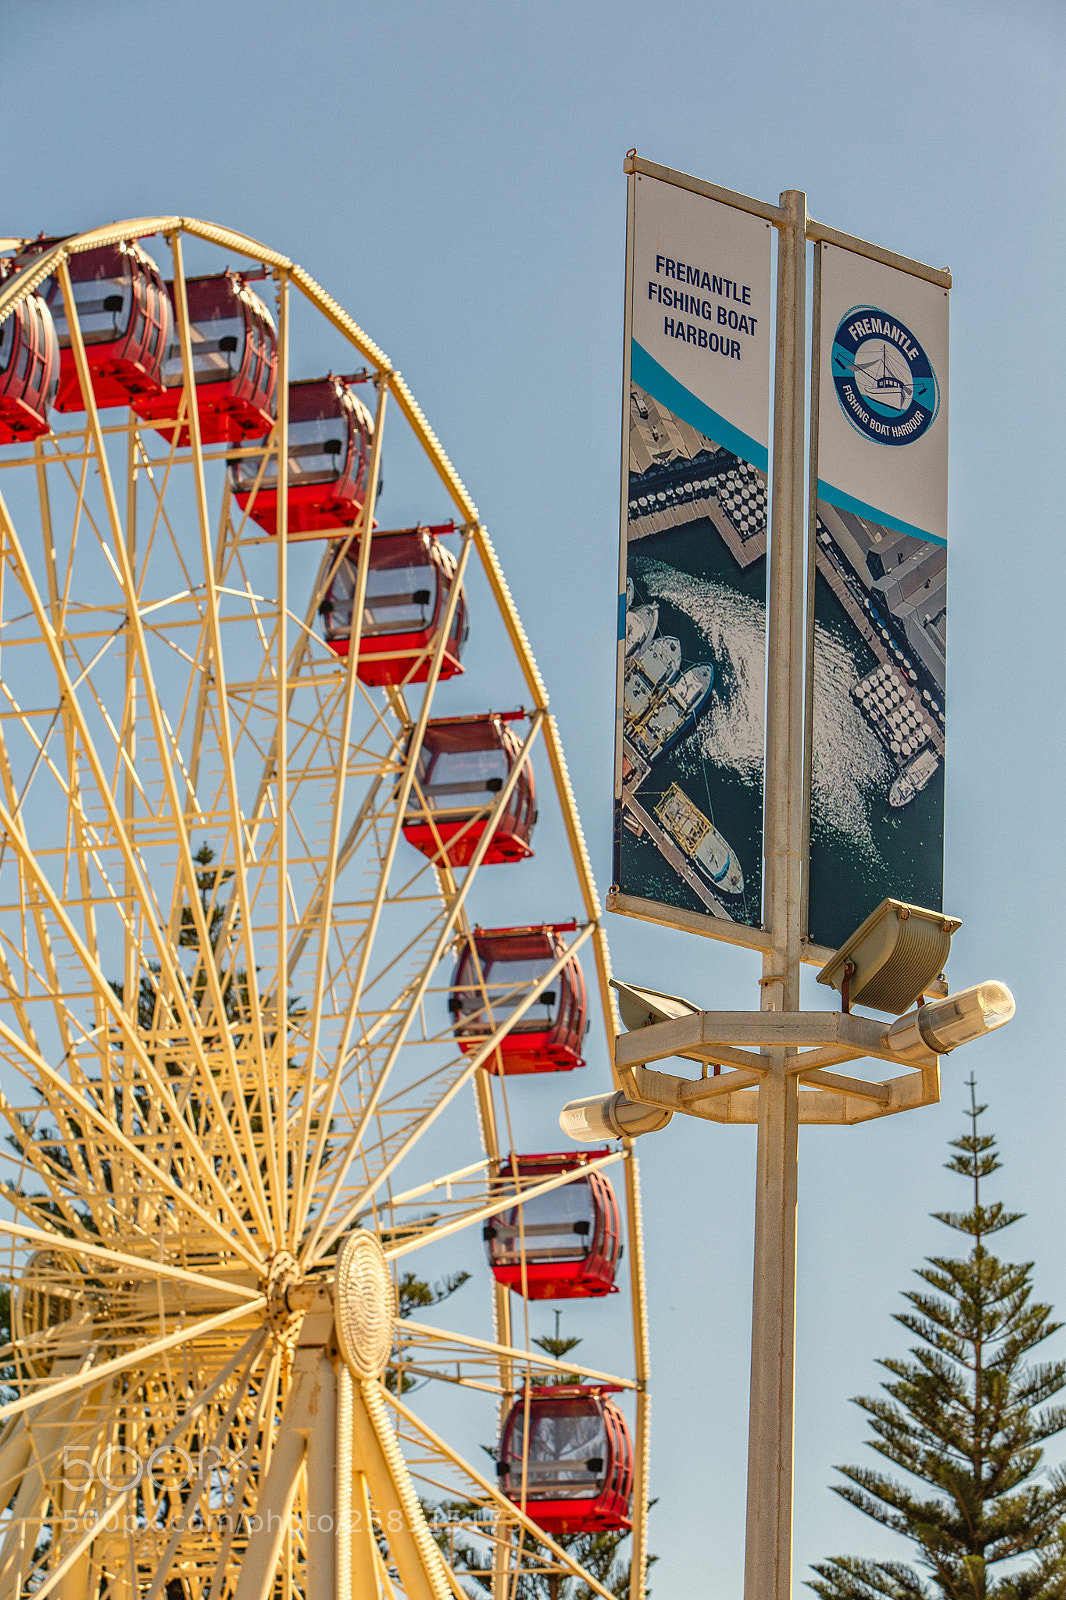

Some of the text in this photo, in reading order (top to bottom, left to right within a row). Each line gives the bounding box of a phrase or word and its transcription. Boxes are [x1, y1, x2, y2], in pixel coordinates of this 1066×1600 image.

[656, 254, 751, 306] FREMANTLE
[648, 281, 757, 336] FISHING BOAT
[664, 316, 741, 360] HARBOUR
[848, 317, 919, 361] FREMANTLE
[842, 384, 925, 438] FISHING BOAT HARBOUR
